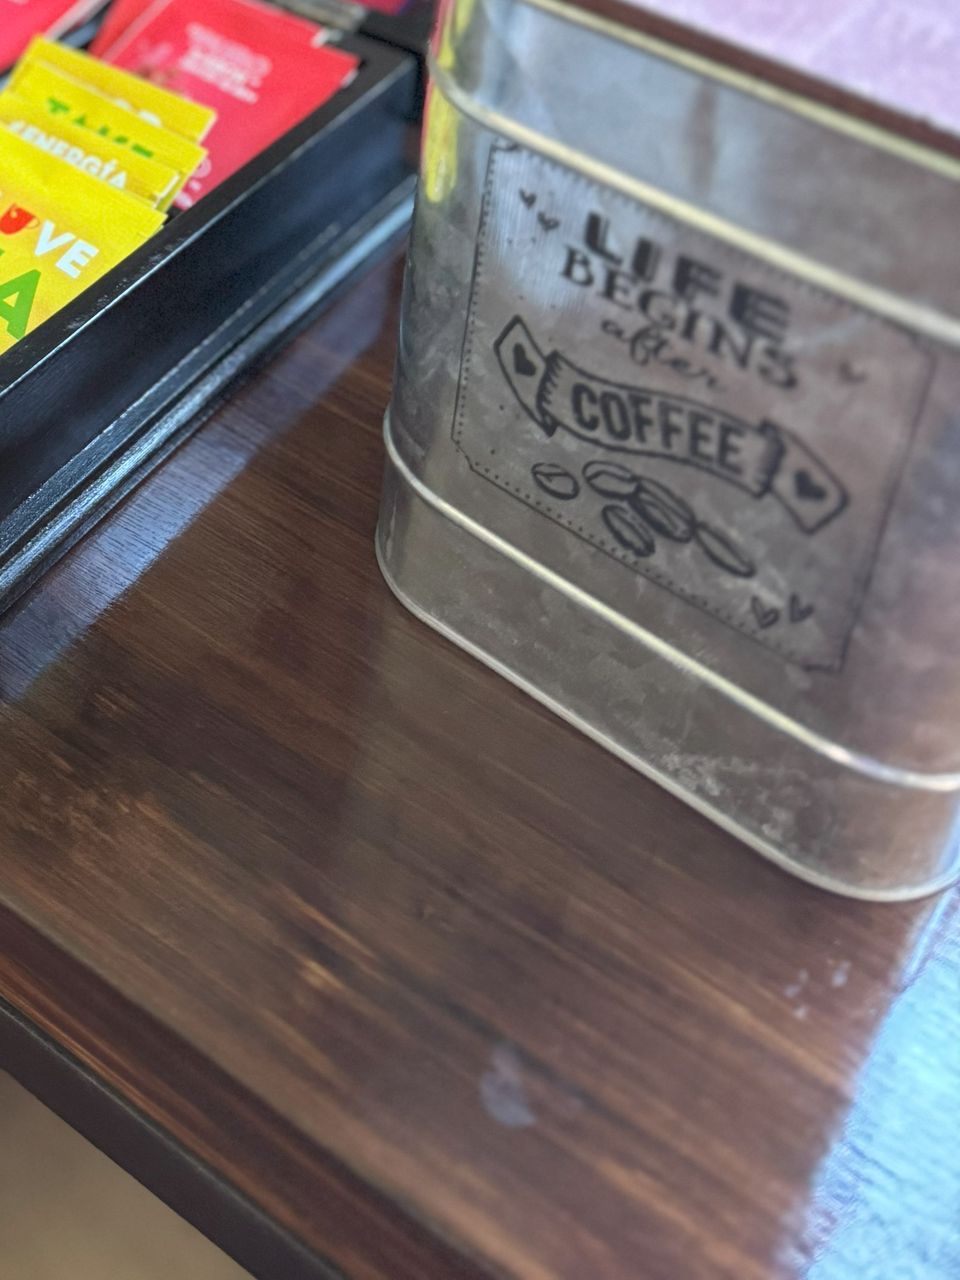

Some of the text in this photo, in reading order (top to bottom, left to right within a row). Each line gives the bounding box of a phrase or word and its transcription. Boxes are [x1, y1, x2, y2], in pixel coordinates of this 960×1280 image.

[558, 244, 799, 390] BEGINS
[583, 211, 792, 347] LIFE
[599, 319, 730, 393] after
[570, 382, 745, 476] COFFEE
